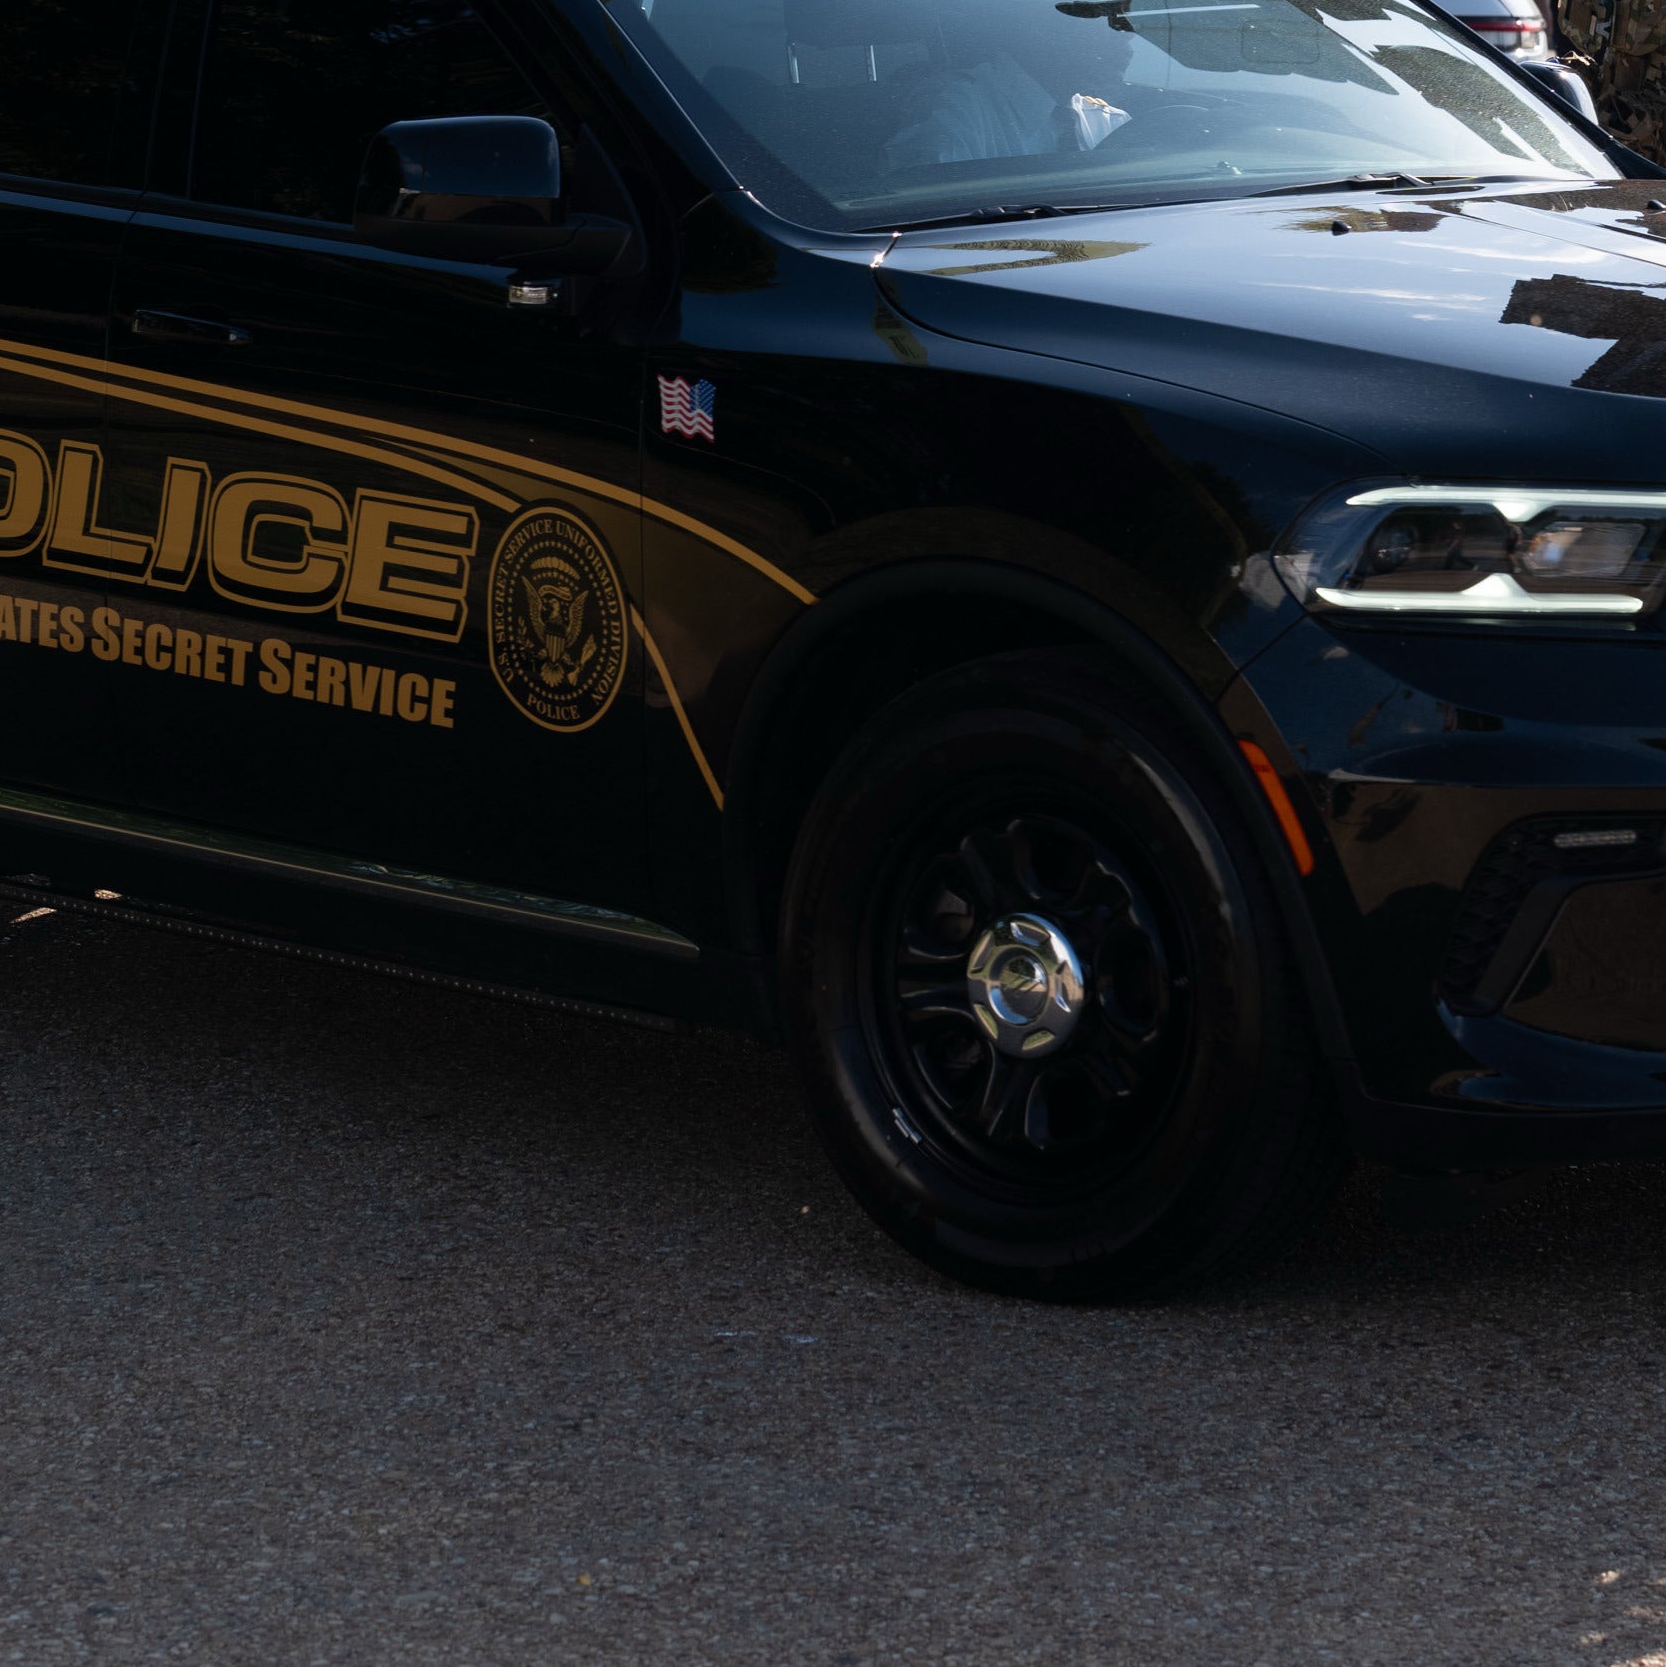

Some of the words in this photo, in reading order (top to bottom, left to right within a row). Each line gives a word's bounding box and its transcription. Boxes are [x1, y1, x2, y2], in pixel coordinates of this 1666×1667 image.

[90, 606, 255, 687] SECRET
[257, 637, 458, 729] SERVICE
[494, 563, 509, 643] SECRET
[504, 519, 553, 563] SERVICE
[556, 520, 619, 615] UNIFORMED
[591, 621, 621, 706] DIVISION
[527, 692, 581, 721] POLICE
